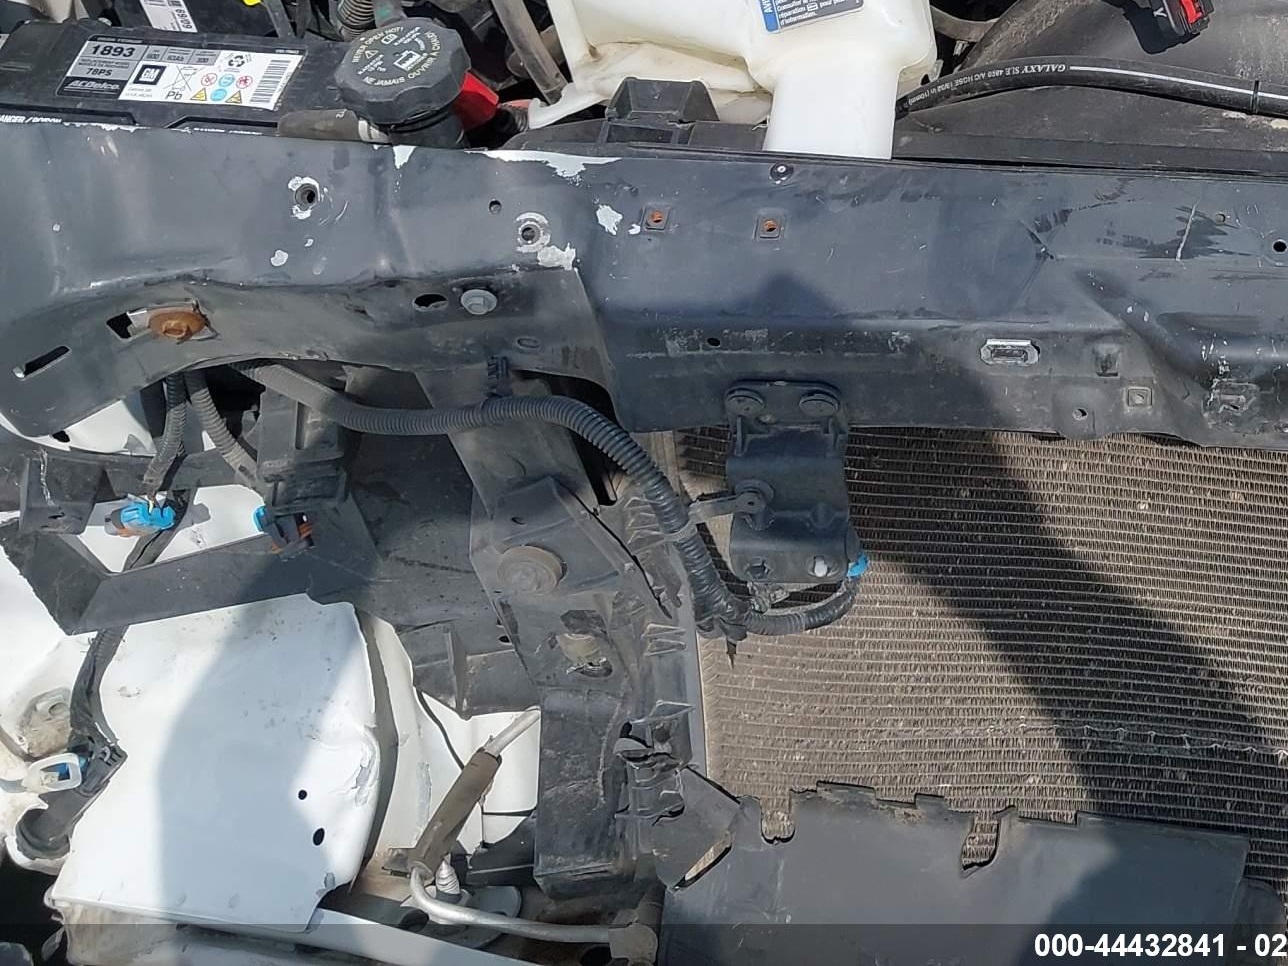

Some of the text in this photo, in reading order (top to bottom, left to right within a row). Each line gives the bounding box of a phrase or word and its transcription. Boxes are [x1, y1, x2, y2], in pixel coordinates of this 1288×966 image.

[365, 33, 384, 45] OPEN
[92, 45, 136, 58] 1893
[86, 68, 113, 77] 78PS
[374, 76, 406, 86] JAMAIS
[408, 57, 437, 79] OUVRIR
[1005, 64, 1020, 76] SLE
[1022, 64, 1066, 74] GALAXY
[955, 74, 974, 87] HOSE
[974, 72, 986, 82] A/C
[165, 90, 183, 101] Pb
[908, 89, 930, 106] (10mm)
